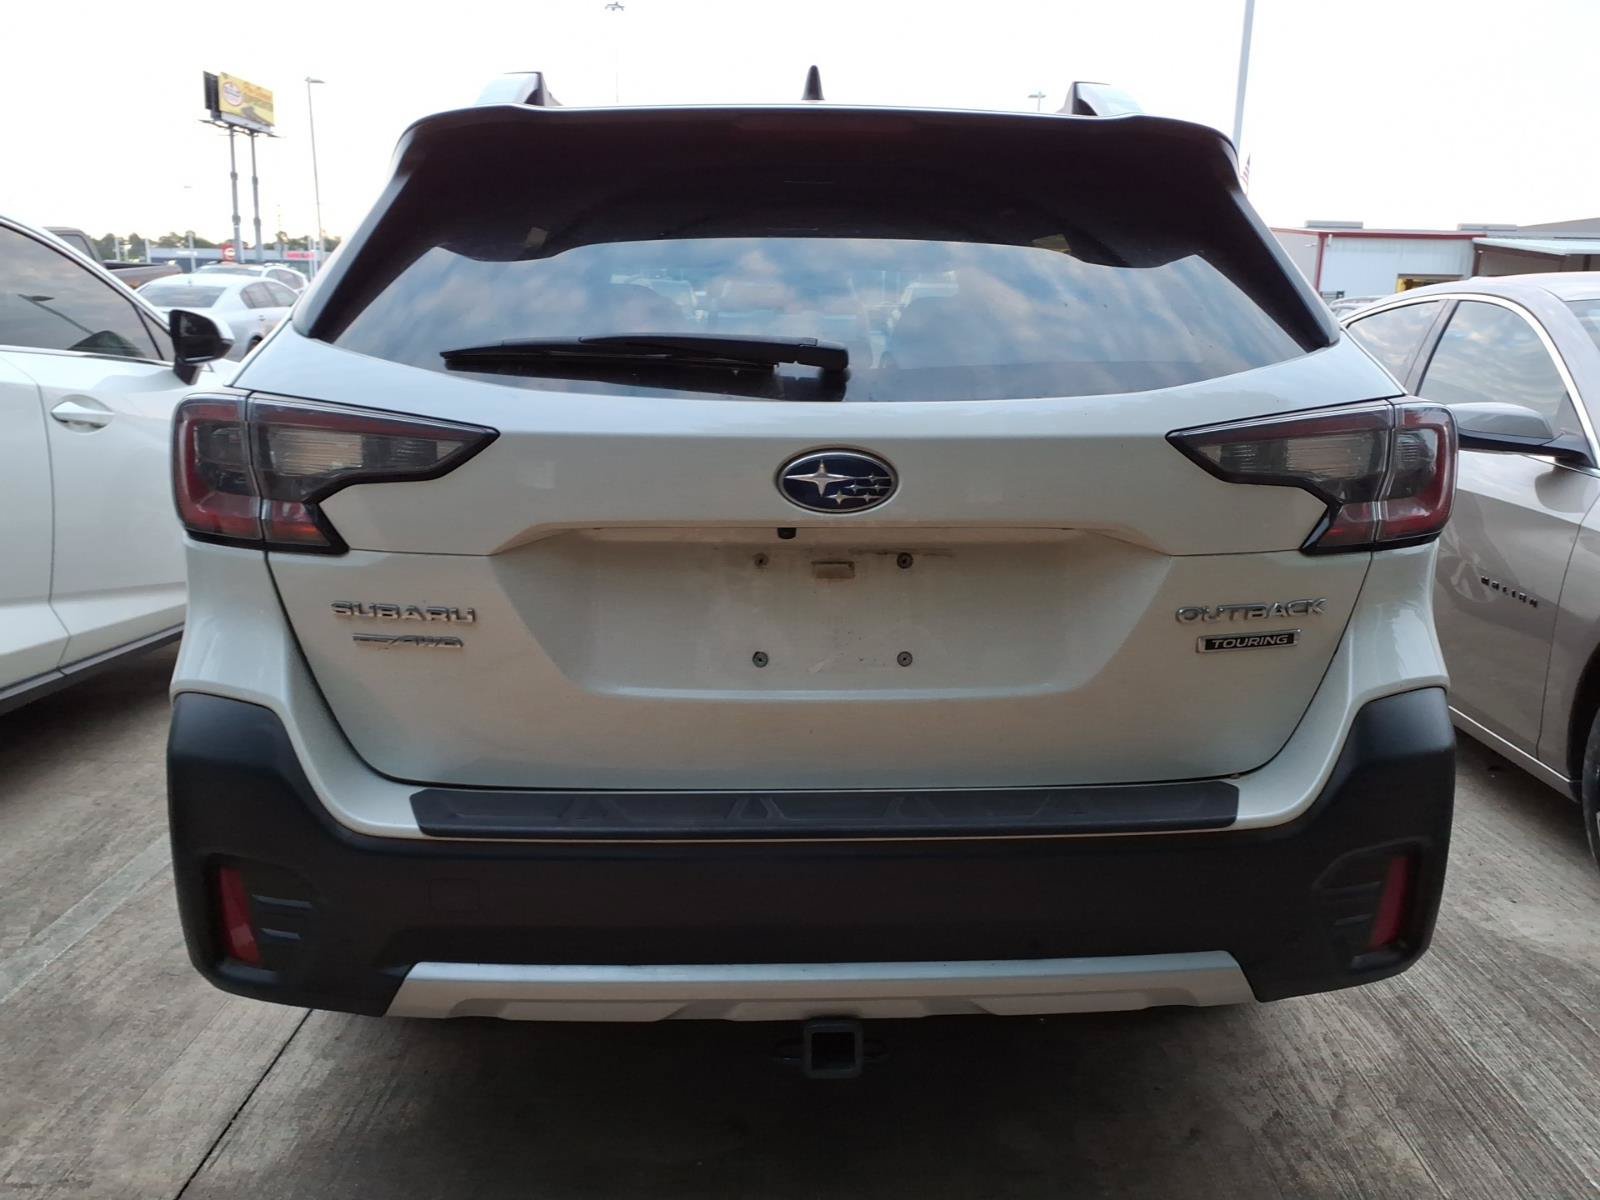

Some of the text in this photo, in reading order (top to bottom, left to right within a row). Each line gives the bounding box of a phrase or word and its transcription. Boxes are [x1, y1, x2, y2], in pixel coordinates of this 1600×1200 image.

[331, 600, 476, 623] SUBARU
[1175, 598, 1326, 623] OUTBACK
[1211, 634, 1288, 649] TOURING
